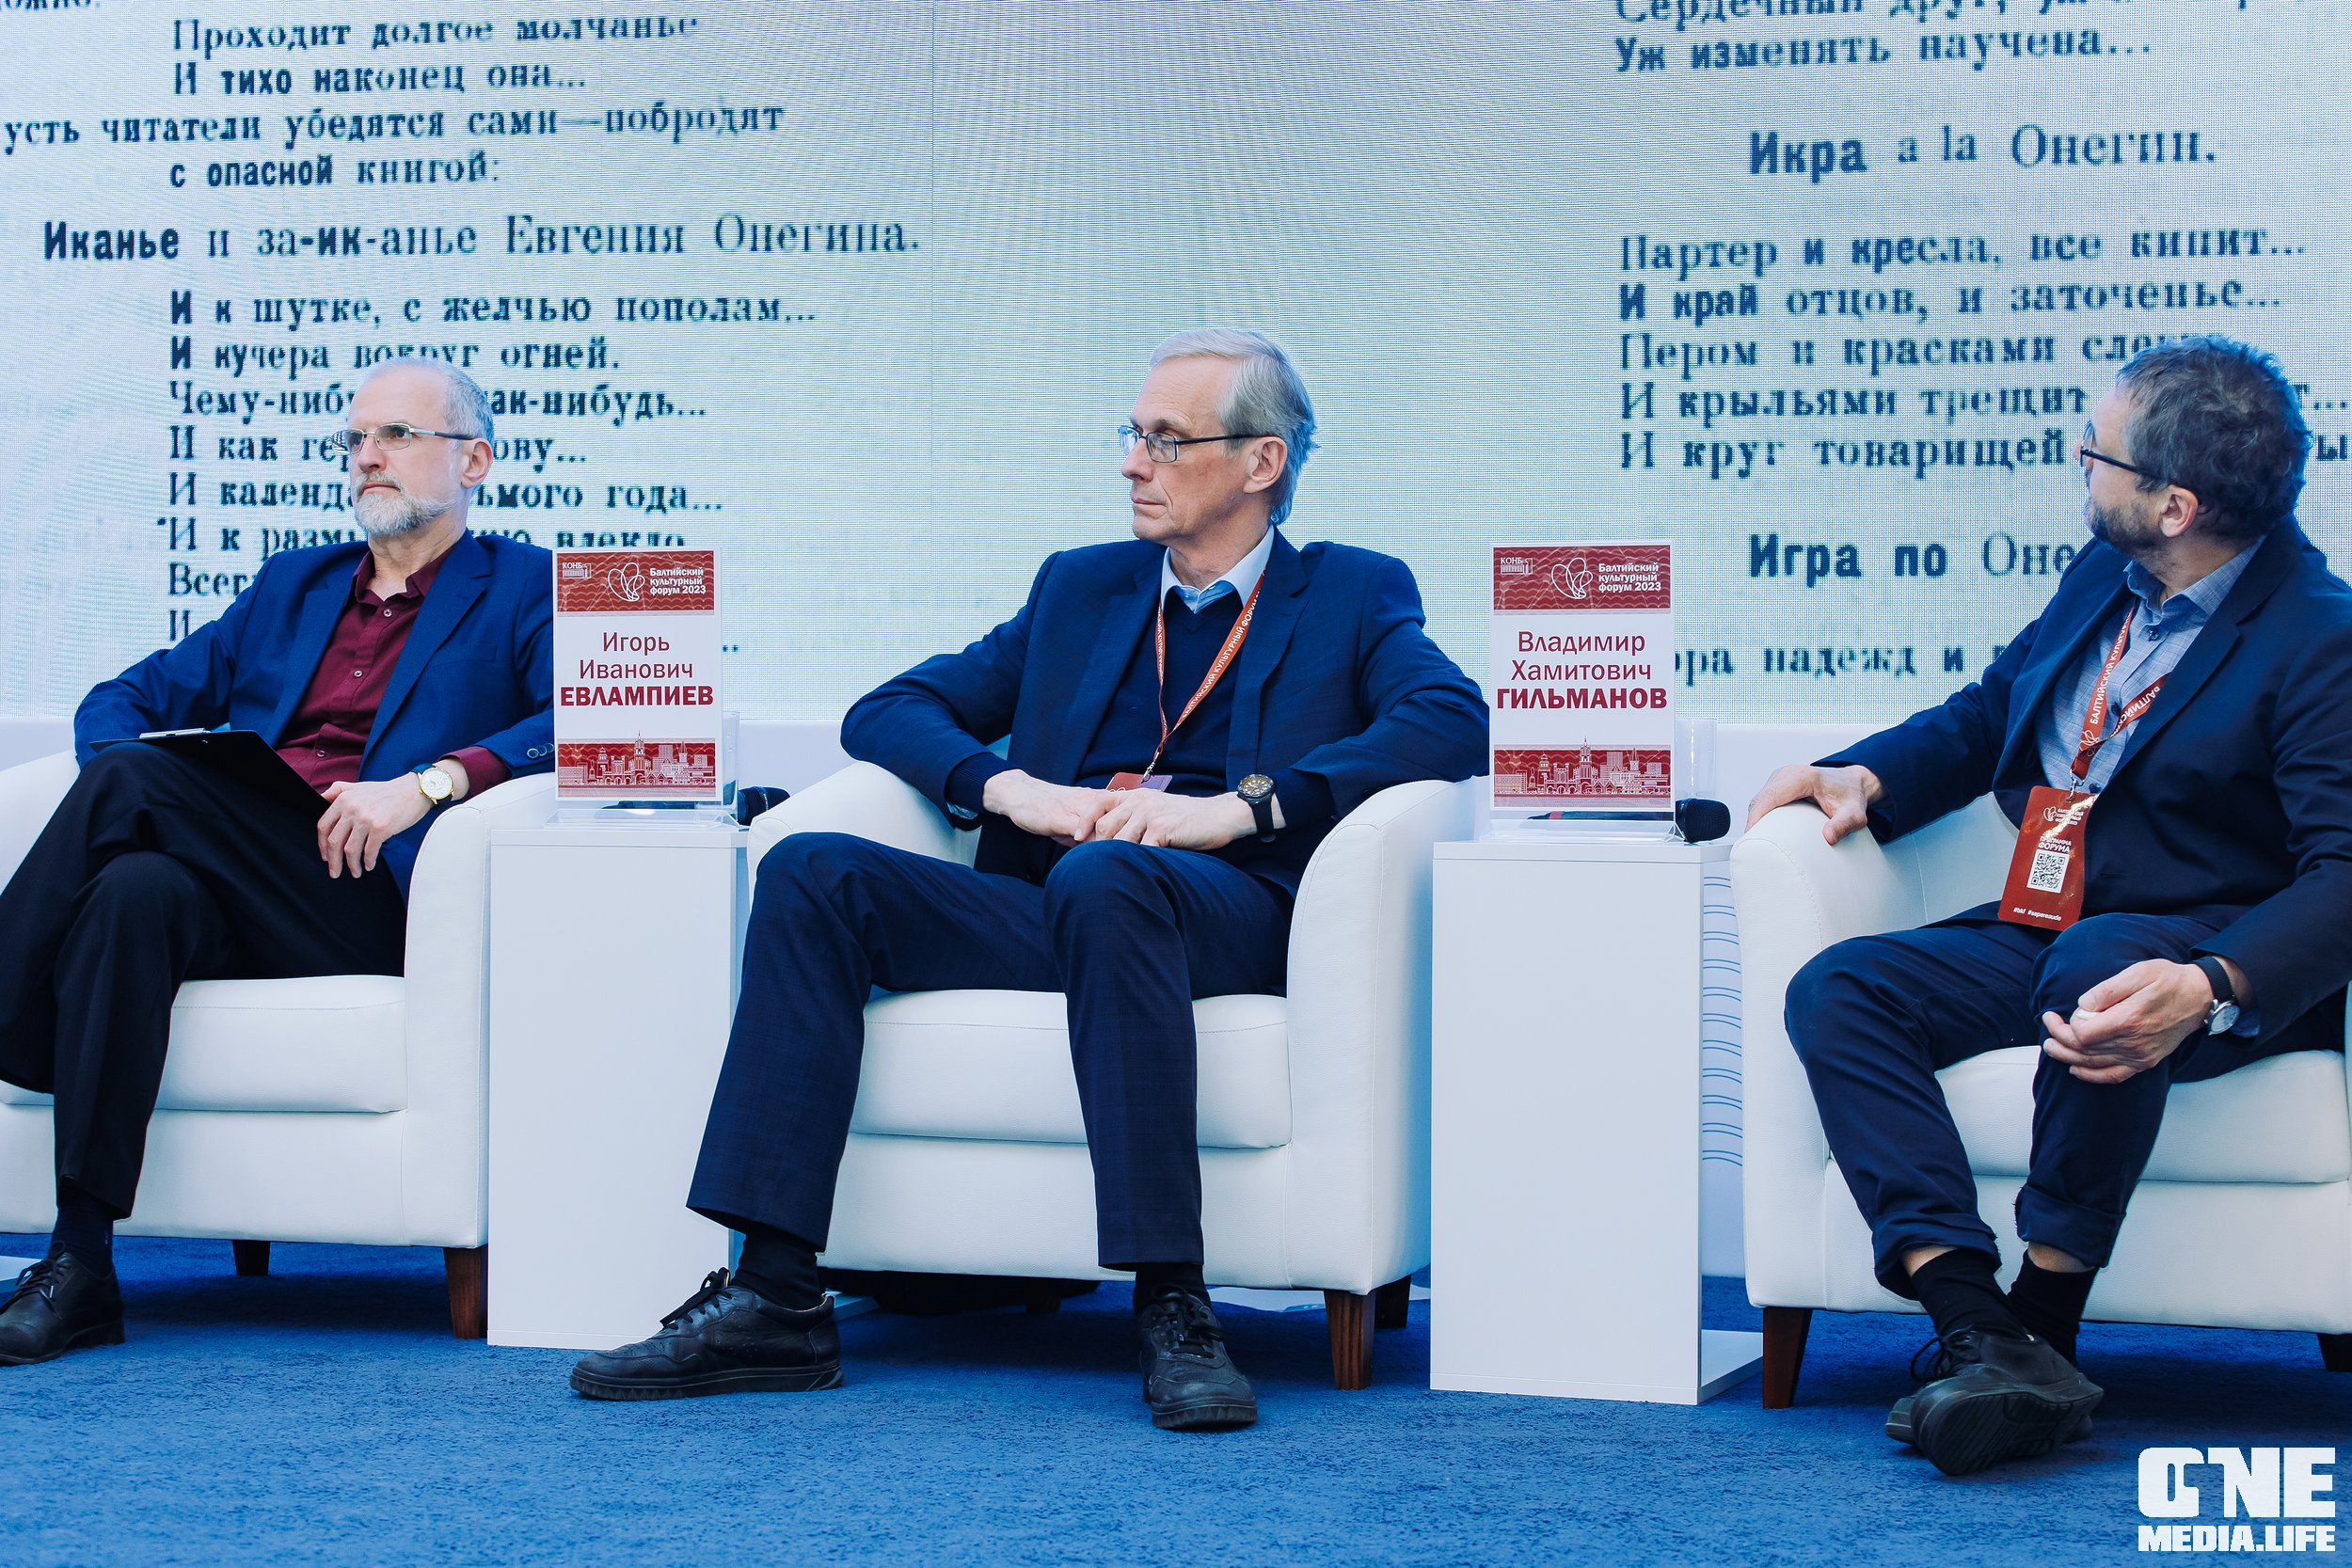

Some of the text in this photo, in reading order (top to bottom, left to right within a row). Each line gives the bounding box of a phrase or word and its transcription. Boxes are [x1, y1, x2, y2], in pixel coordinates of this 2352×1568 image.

[174, 16, 698, 59] Проходит долгое молчанье
[1614, 28, 2150, 71] Уж изменять научена...
[174, 63, 585, 94] И тихо наконец она...
[102, 117, 262, 144] читатели
[285, 108, 444, 150] убедятся
[170, 150, 499, 187] с опасной книгой:
[1750, 131, 1867, 183] Икра
[1943, 124, 1977, 162] la
[2011, 123, 2216, 167] Онегин.
[44, 221, 180, 261] Иканье
[257, 225, 477, 257] за-ик-анье
[506, 214, 684, 254] Евгения
[715, 213, 919, 253] Онегина.
[1621, 229, 2305, 281] Партер и кресла, все кипит...
[170, 289, 817, 331] И к шутке, с желчью пополам...
[1620, 278, 2280, 327] И край отцов, и заточенье...
[170, 335, 192, 370] И
[215, 343, 328, 381] кучера
[501, 336, 620, 370] огней.
[1621, 332, 1757, 379] Пером
[1793, 341, 1815, 365] и
[1844, 337, 2055, 376] красками
[170, 380, 706, 427] Чему-ниб ак-нибудь...
[1621, 381, 2087, 429] И крыльями трещит
[170, 424, 194, 460] И
[218, 436, 277, 461] как
[493, 436, 587, 472] ову...
[1621, 431, 1654, 468] И
[1682, 440, 1786, 480] круг
[1814, 429, 2065, 481] товарищей
[169, 472, 723, 515] И календ ьмого года...
[169, 516, 196, 550] И
[220, 528, 240, 551] к
[169, 561, 256, 595] Всег
[649, 566, 704, 577] Балтийский
[1598, 562, 1660, 572] Балтийский
[1598, 571, 1658, 583] культурный
[1748, 531, 2077, 588] Игра по Оне
[649, 576, 703, 587] культурный
[649, 585, 707, 596] форум 2023
[1598, 581, 1662, 594] форум 2023
[603, 632, 670, 656] Игорь
[1213, 626, 1246, 673] КУЛЬТУРНЫЙ
[1518, 630, 1645, 656] Владимир
[1763, 644, 1916, 677] надежд
[1943, 645, 1963, 672] и
[580, 659, 693, 679] Иванович
[1511, 659, 1651, 681] Хамитович
[560, 686, 714, 706] ЕВЛАМПИЕВ
[1497, 688, 1667, 709] ГИЛЬМАНОВ
[2090, 661, 2115, 725] БАЛТИЙСКИЙ
[2038, 842, 2071, 853] ФОРУМА
